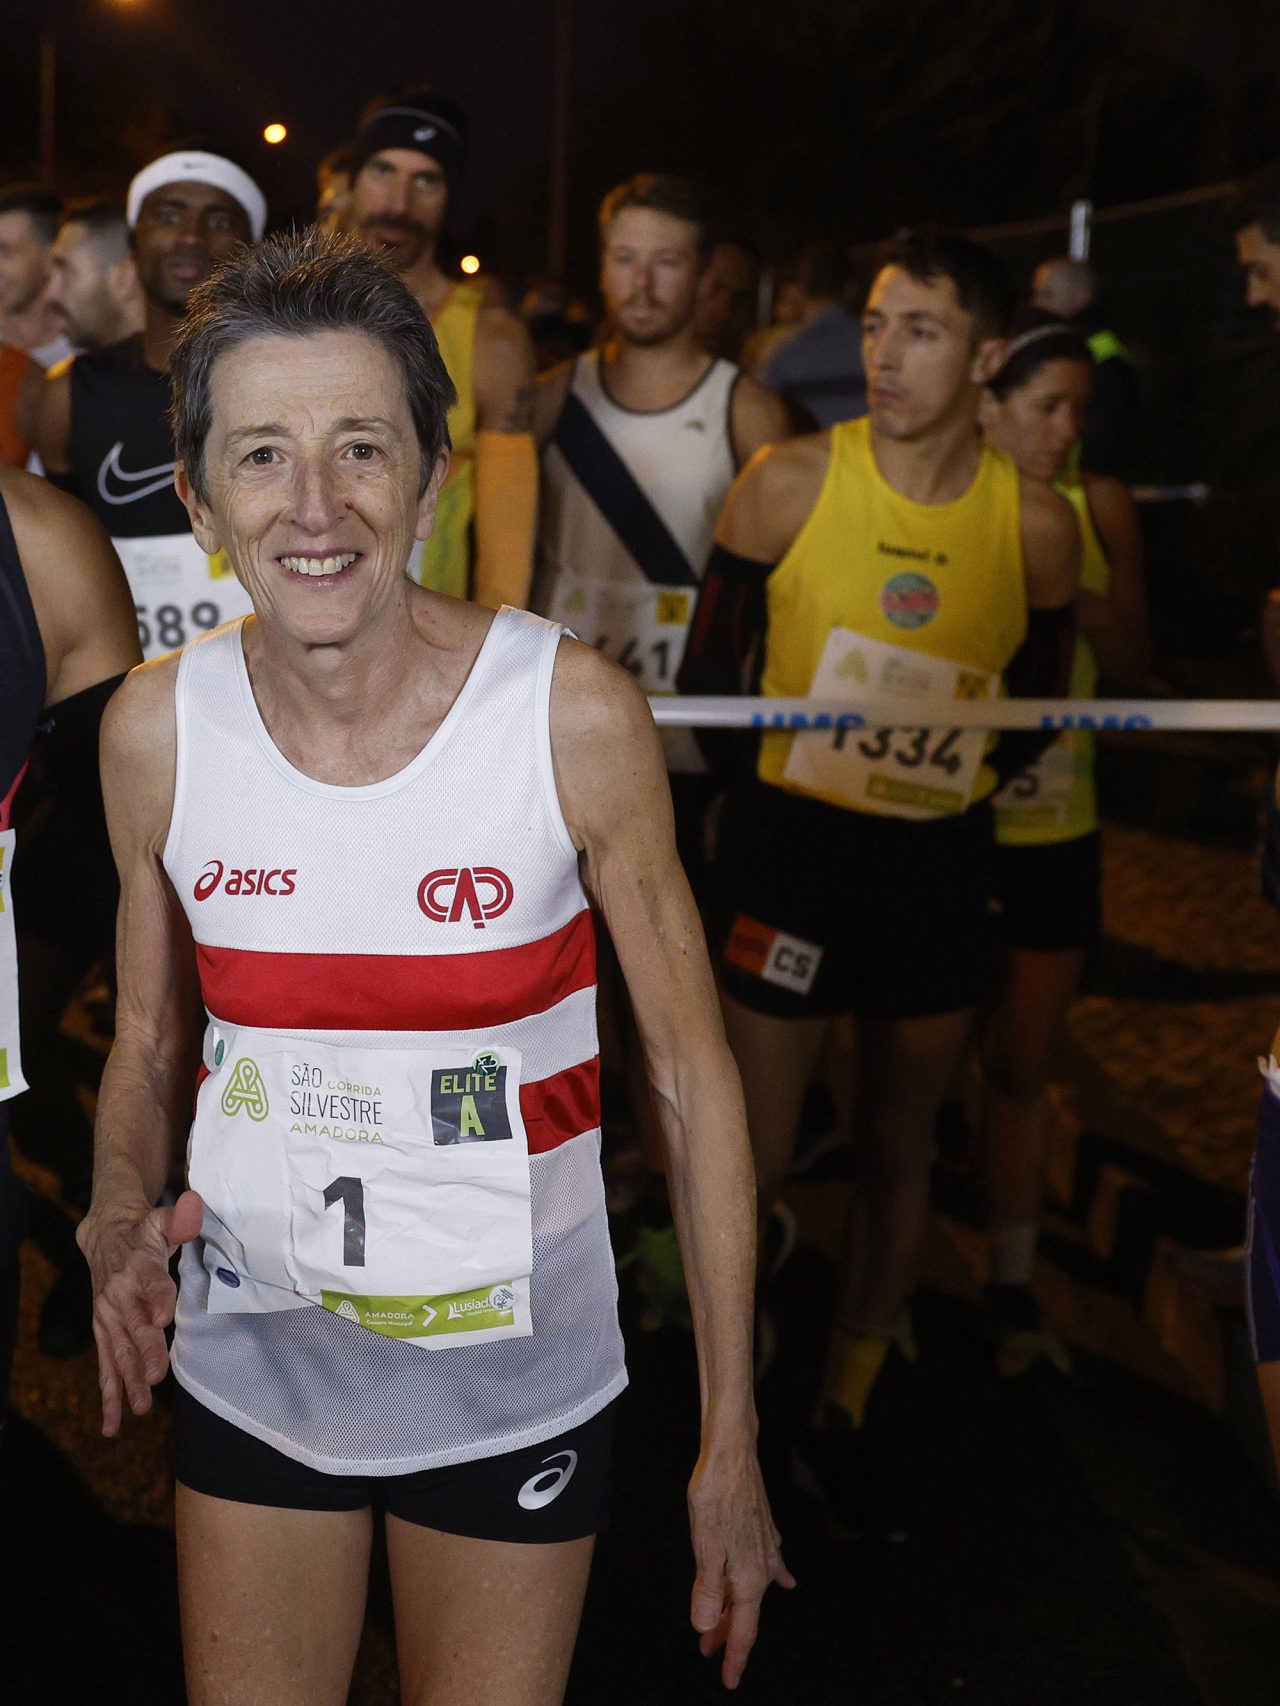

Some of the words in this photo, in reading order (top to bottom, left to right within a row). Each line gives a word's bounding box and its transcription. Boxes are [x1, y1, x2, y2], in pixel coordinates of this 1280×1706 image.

[224, 868, 297, 896] asics
[773, 946, 814, 981] CS
[290, 1062, 322, 1088] SÃO
[327, 1080, 382, 1096] CORRIDA
[439, 1072, 497, 1095] ELITE
[290, 1091, 383, 1125] SILVESTRE
[460, 1095, 485, 1137] A
[289, 1122, 384, 1144] AMADORA
[323, 1176, 366, 1267] 1
[365, 1311, 415, 1320] AMADORA
[454, 1297, 491, 1313] Lusíad
